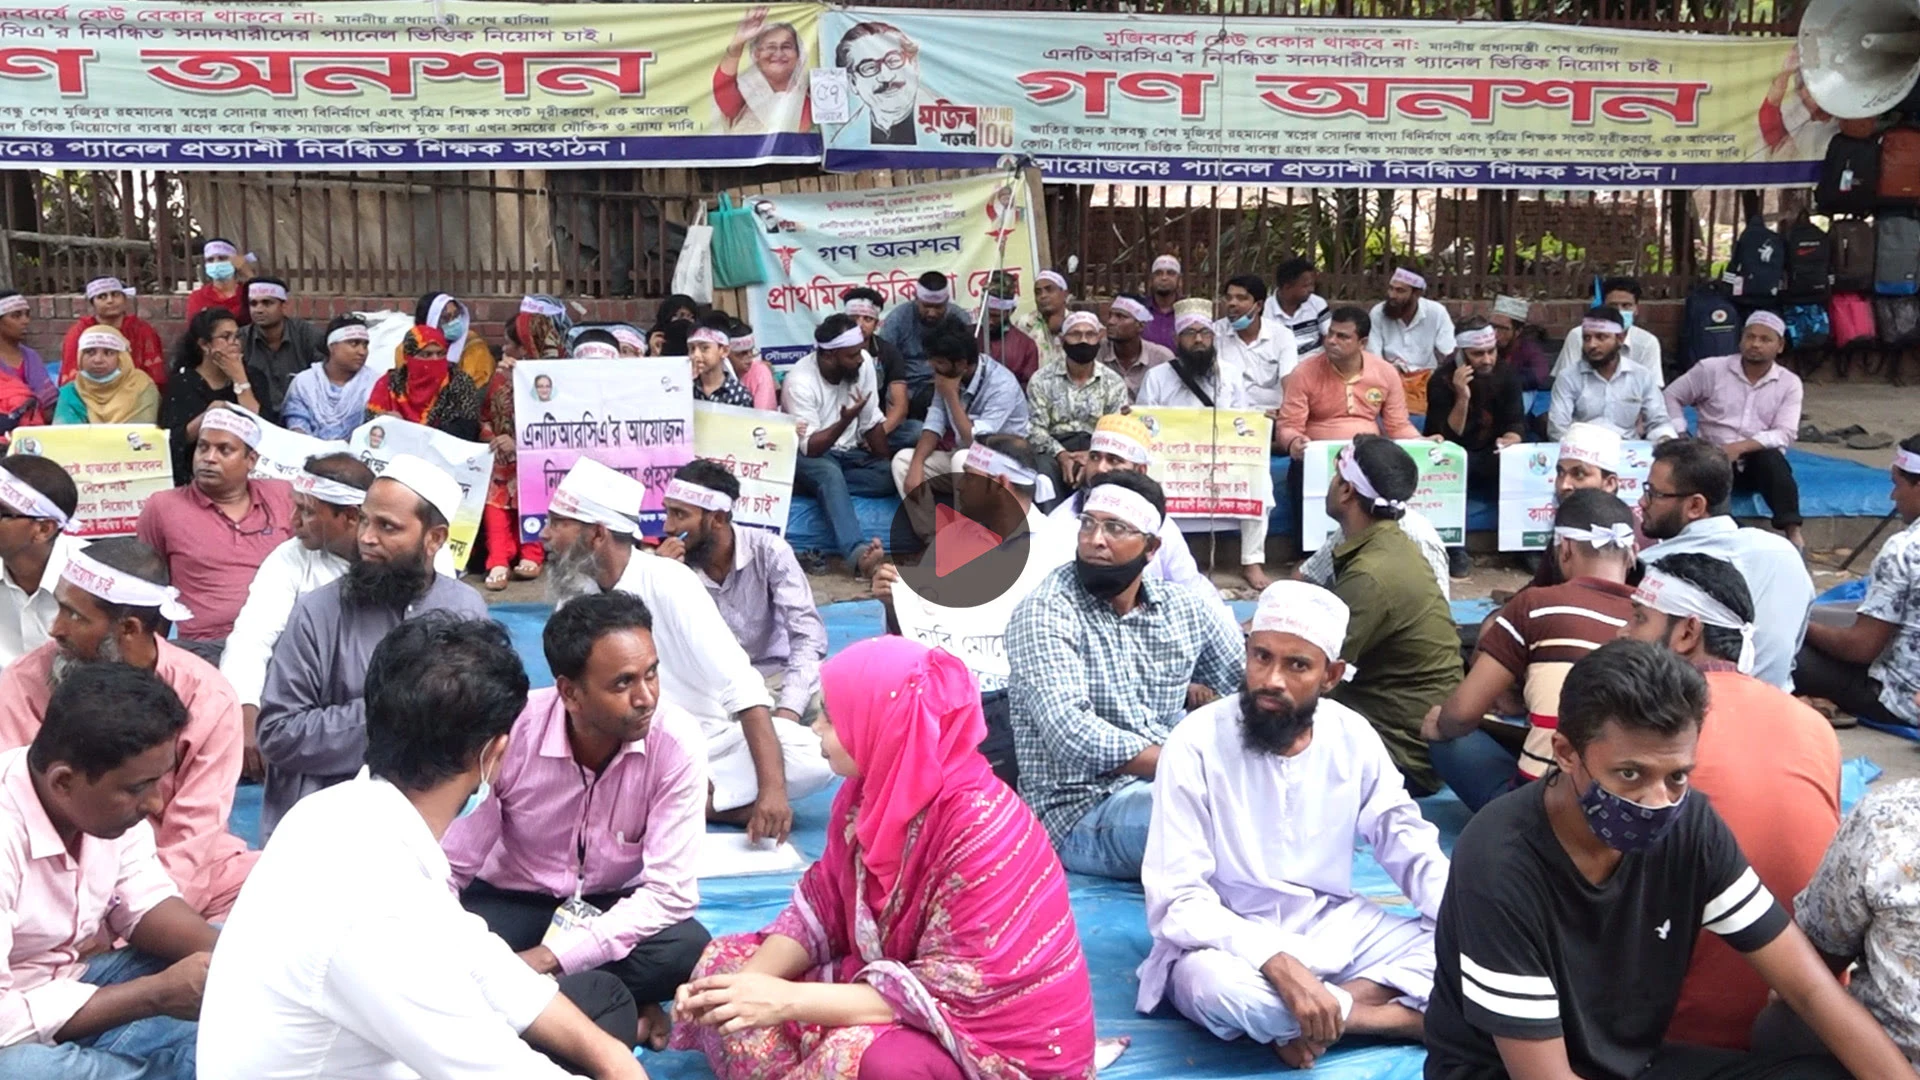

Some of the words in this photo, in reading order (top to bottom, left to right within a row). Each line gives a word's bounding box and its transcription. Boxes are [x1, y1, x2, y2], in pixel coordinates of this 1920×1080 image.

[78, 6, 125, 22] কেউ
[137, 9, 205, 23] বেকার
[214, 10, 285, 24] থাকবে
[334, 13, 388, 25] মাননীয়
[393, 13, 460, 26] প্রধানন্ত্রী
[467, 15, 497, 26] শেখ
[503, 14, 551, 26] হাসিনা
[80, 23, 164, 40] নিবন্ধিত
[173, 26, 312, 42] সনদধারীদের
[321, 29, 398, 42] প্যানেল
[406, 27, 476, 42] ভিত্তিক
[484, 27, 555, 42] নিয়োগ
[561, 27, 600, 43] চাই
[1103, 29, 1198, 47] মুজিববর্ষে
[1256, 35, 1316, 49] বেকার
[1323, 36, 1385, 50] থাকবে
[1544, 44, 1572, 54] শেখ
[1576, 43, 1620, 56] হাসিনা
[1202, 48, 1279, 67] নিবন্ধিত
[1285, 51, 1407, 68] সনদধারীদের
[1414, 56, 1483, 69] প্যানেল
[1489, 55, 1551, 70] ভিত্তিক
[1558, 56, 1621, 72] নিয়োগ
[1626, 58, 1662, 73] চাই
[139, 48, 655, 98] অনশন
[1017, 69, 1218, 120] গণ
[1255, 74, 1709, 126] অনশন
[30, 107, 59, 117] শেখ
[64, 104, 109, 119] মুজিবুর
[115, 106, 173, 117] রহমানের
[223, 107, 267, 118] সোনার
[273, 107, 308, 118] বাংলা
[376, 107, 405, 118] এবং
[450, 105, 490, 118] শিক্ষক
[495, 105, 532, 118] সংকট
[605, 106, 628, 116] এক
[918, 98, 978, 133] মুজিব
[979, 106, 1014, 121] MUJIB
[22, 120, 66, 132] ভিত্তিক
[71, 120, 132, 132] নিয়োগের
[218, 123, 245, 133] করে
[250, 121, 291, 134] শিক্ষক
[297, 123, 352, 134] সমাজকে
[357, 121, 412, 134] অভিশাপ
[445, 123, 470, 133] করা
[475, 123, 506, 133] এখন
[512, 123, 556, 132] সময়ের
[668, 118, 695, 131] দাবি
[1030, 123, 1069, 135] জাতির
[1074, 126, 1106, 136] জনক
[1153, 128, 1177, 137] শেখ
[1227, 129, 1279, 140] রহমানের
[1322, 130, 1362, 140] সোনার
[1366, 131, 1397, 141] বাংলা
[1456, 132, 1482, 142] এবং
[1521, 131, 1557, 142] শিক্ষক
[1562, 132, 1597, 143] সংকট
[1661, 133, 1682, 143] এক
[66, 140, 172, 158] প্যানেল
[179, 137, 288, 159] প্রত্যাশী
[295, 137, 407, 159] নিবন্ধিত
[413, 137, 506, 158] শিক্ষক
[511, 135, 611, 158] সংগঠন
[1021, 138, 1053, 150] কোটা
[1058, 138, 1092, 151] বিহীন
[1097, 141, 1140, 151] প্যানেল
[1145, 140, 1182, 153] ভিত্তিক
[1316, 145, 1340, 155] করে
[1344, 143, 1381, 155] শিক্ষক
[1517, 147, 1539, 157] করা
[1181, 160, 1274, 177] প্যানেল
[1281, 158, 1377, 178] প্রত্যাশী
[1382, 160, 1482, 179] নিবন্ধিত
[1488, 160, 1568, 179] শিক্ষক
[1574, 162, 1663, 181] সংগঠন
[818, 243, 859, 263] গণ
[866, 235, 962, 259] অনশন
[625, 418, 685, 446] আয়োজন
